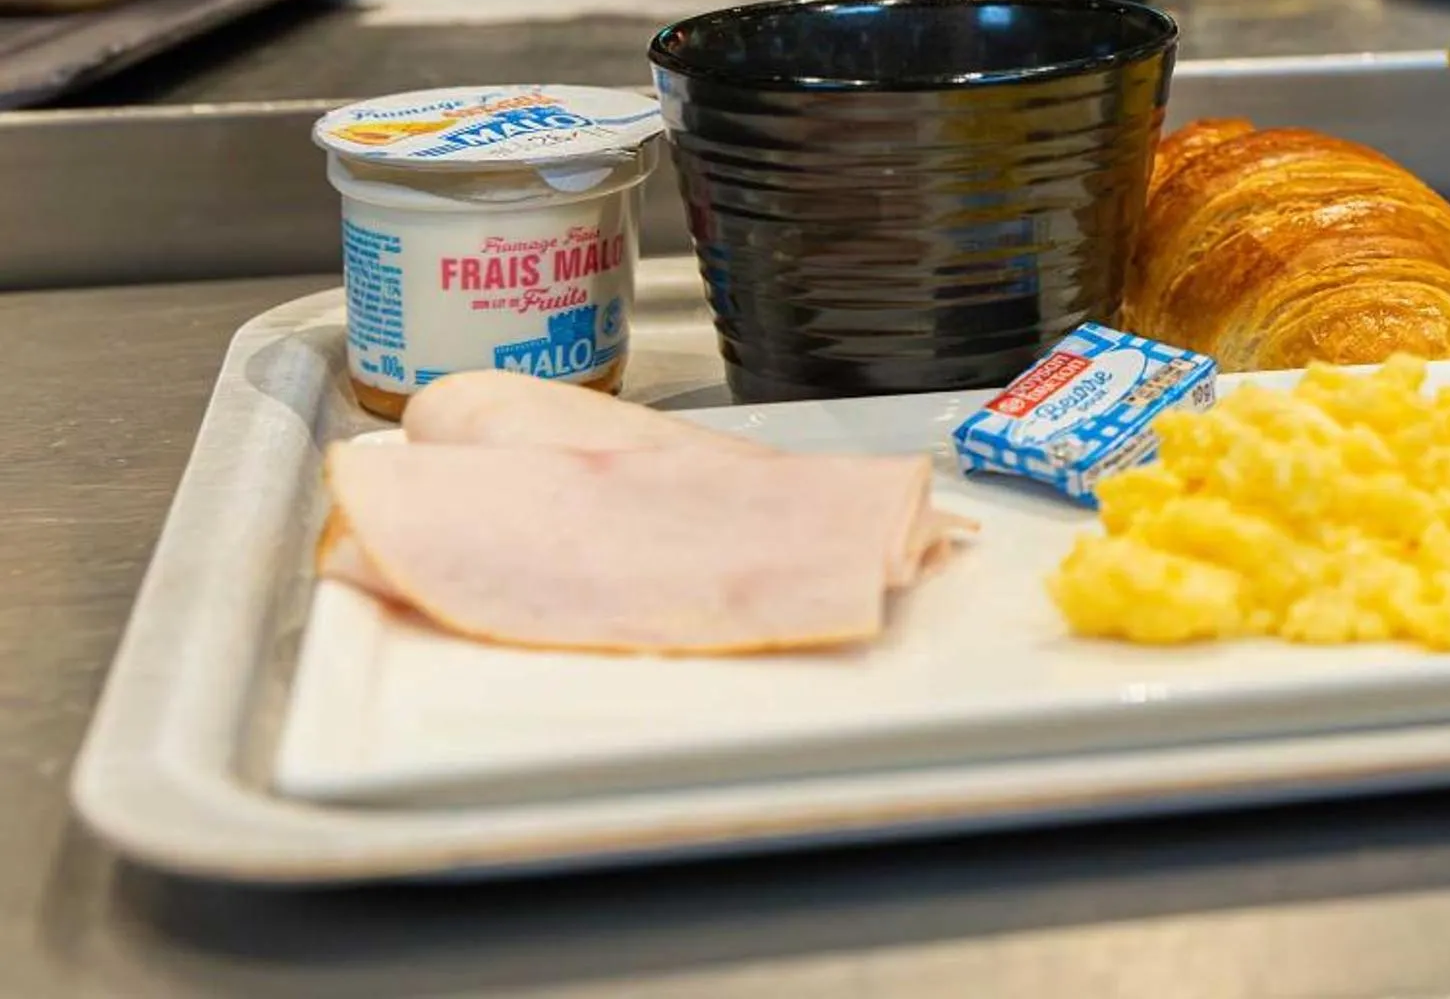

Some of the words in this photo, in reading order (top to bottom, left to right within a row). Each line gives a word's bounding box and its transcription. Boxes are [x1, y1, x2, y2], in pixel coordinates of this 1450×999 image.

[458, 113, 593, 146] MALO
[482, 236, 558, 253] Fromage
[441, 254, 541, 290] FRAIS
[554, 233, 625, 282] MALO
[519, 286, 588, 313] Fruits
[503, 338, 592, 377] MALO
